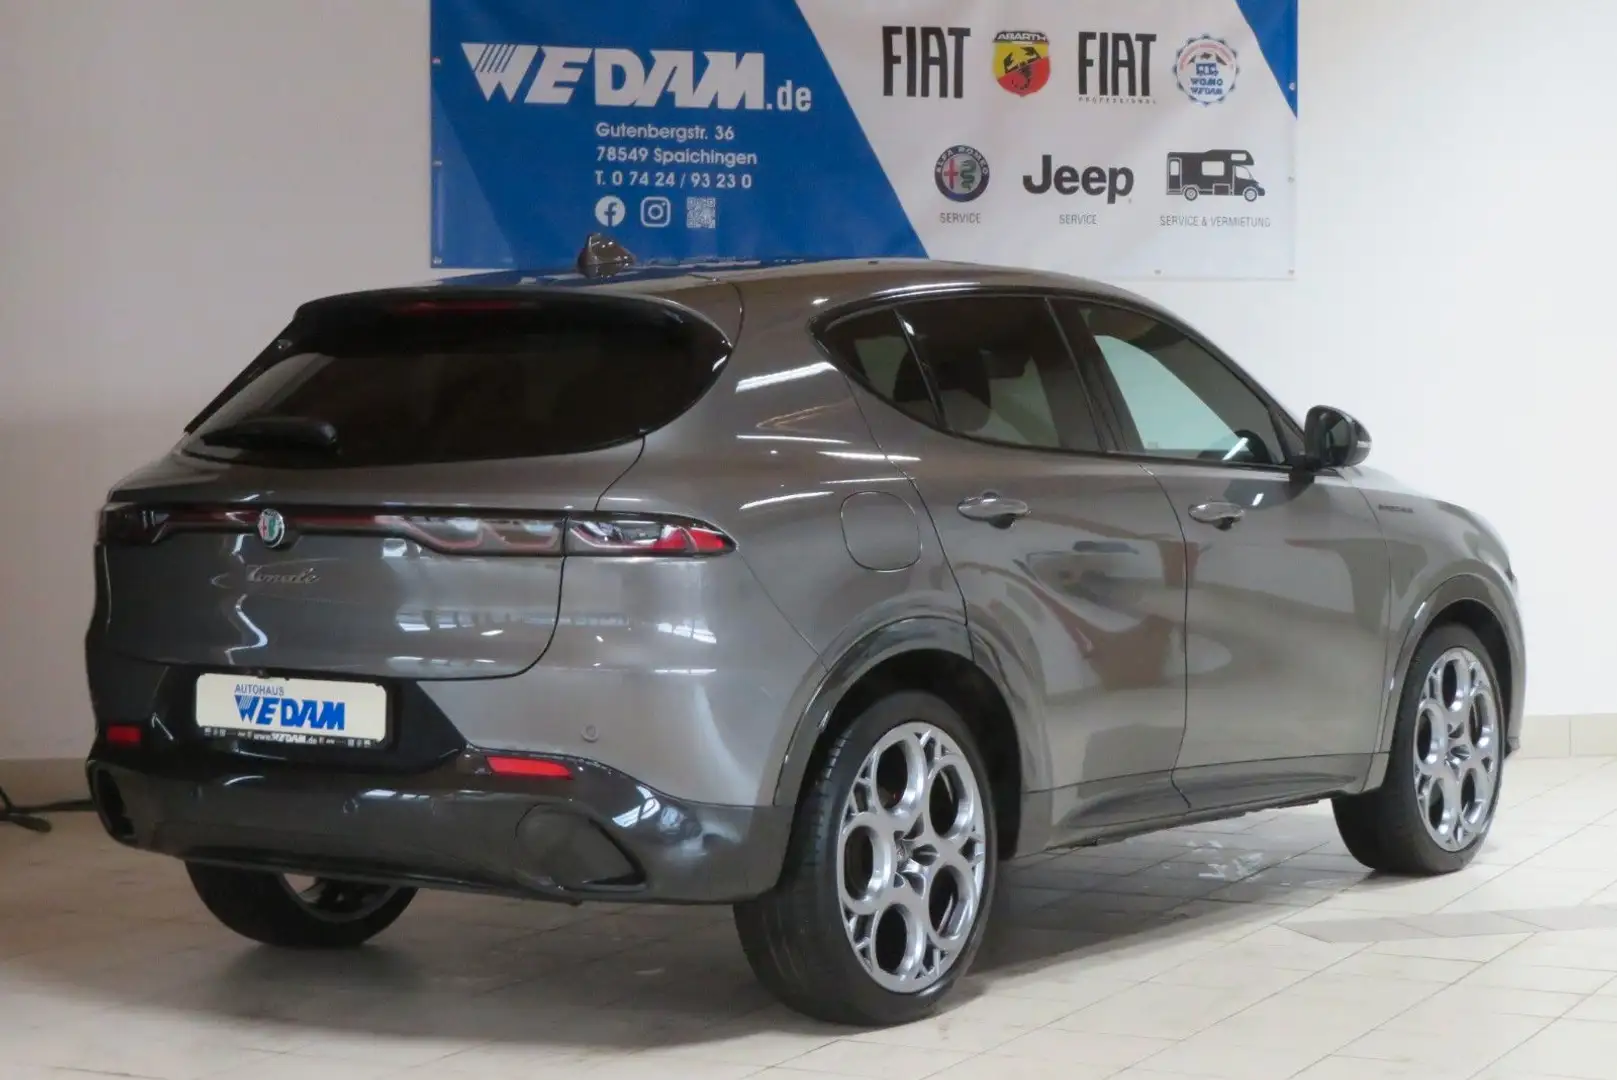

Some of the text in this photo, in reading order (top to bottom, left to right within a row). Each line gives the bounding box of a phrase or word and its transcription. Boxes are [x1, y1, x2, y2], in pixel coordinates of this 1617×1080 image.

[996, 31, 1048, 42] ABARTH
[882, 25, 971, 99] FIAT
[1078, 31, 1157, 97] FIAT
[1190, 77, 1224, 86] WOMO
[595, 122, 735, 143] Gutenbergstr. 36
[596, 145, 757, 168] 78549 Spaichingen
[958, 146, 989, 175] ROMEO
[595, 169, 606, 185] T.
[629, 171, 649, 186] 74
[655, 171, 675, 187] 24
[691, 172, 710, 188] 93
[716, 173, 736, 188] 23
[1022, 154, 1134, 204] Jeep
[939, 212, 982, 224] SERVICE
[1059, 213, 1097, 225] SERVICE
[1160, 215, 1271, 228] SERVICE & VERMIETUNG
[234, 683, 285, 696] AUTOHAUS
[234, 694, 346, 731] WEDAM
